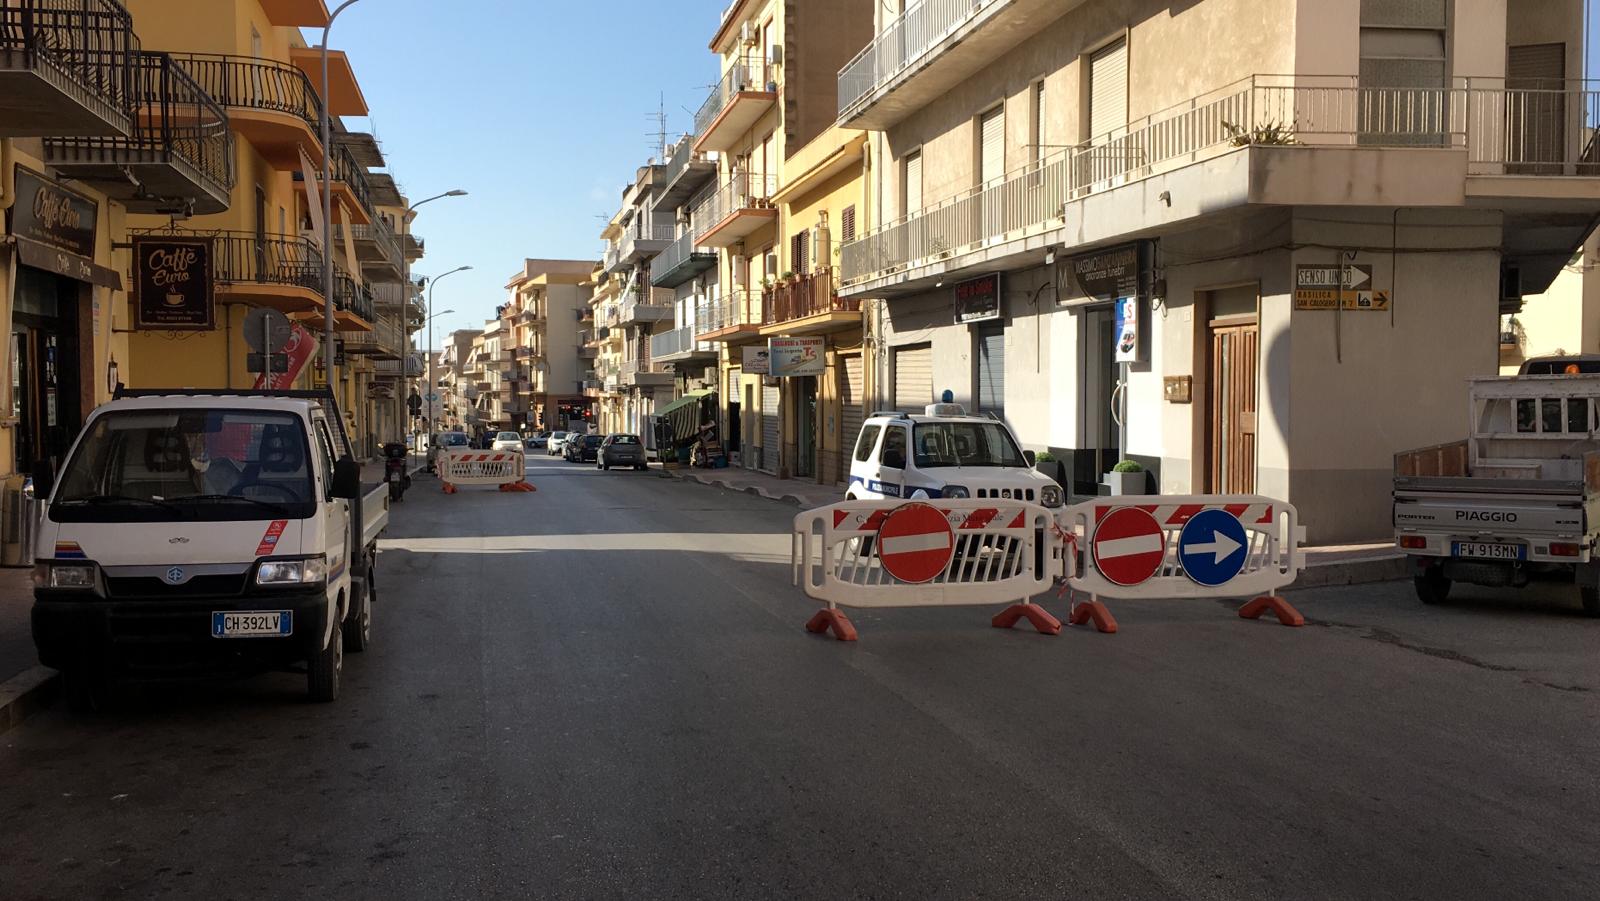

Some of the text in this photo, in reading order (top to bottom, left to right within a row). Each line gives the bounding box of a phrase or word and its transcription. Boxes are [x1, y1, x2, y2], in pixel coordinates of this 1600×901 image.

[149, 247, 198, 272] Caffè
[151, 269, 190, 287] Euro
[1299, 270, 1352, 284] SENSO UNCO
[1297, 290, 1331, 299] BASILICA
[1455, 510, 1517, 523] PIAGGIO
[1459, 543, 1517, 558] FW 913MN
[225, 615, 280, 630] CH 392LV
